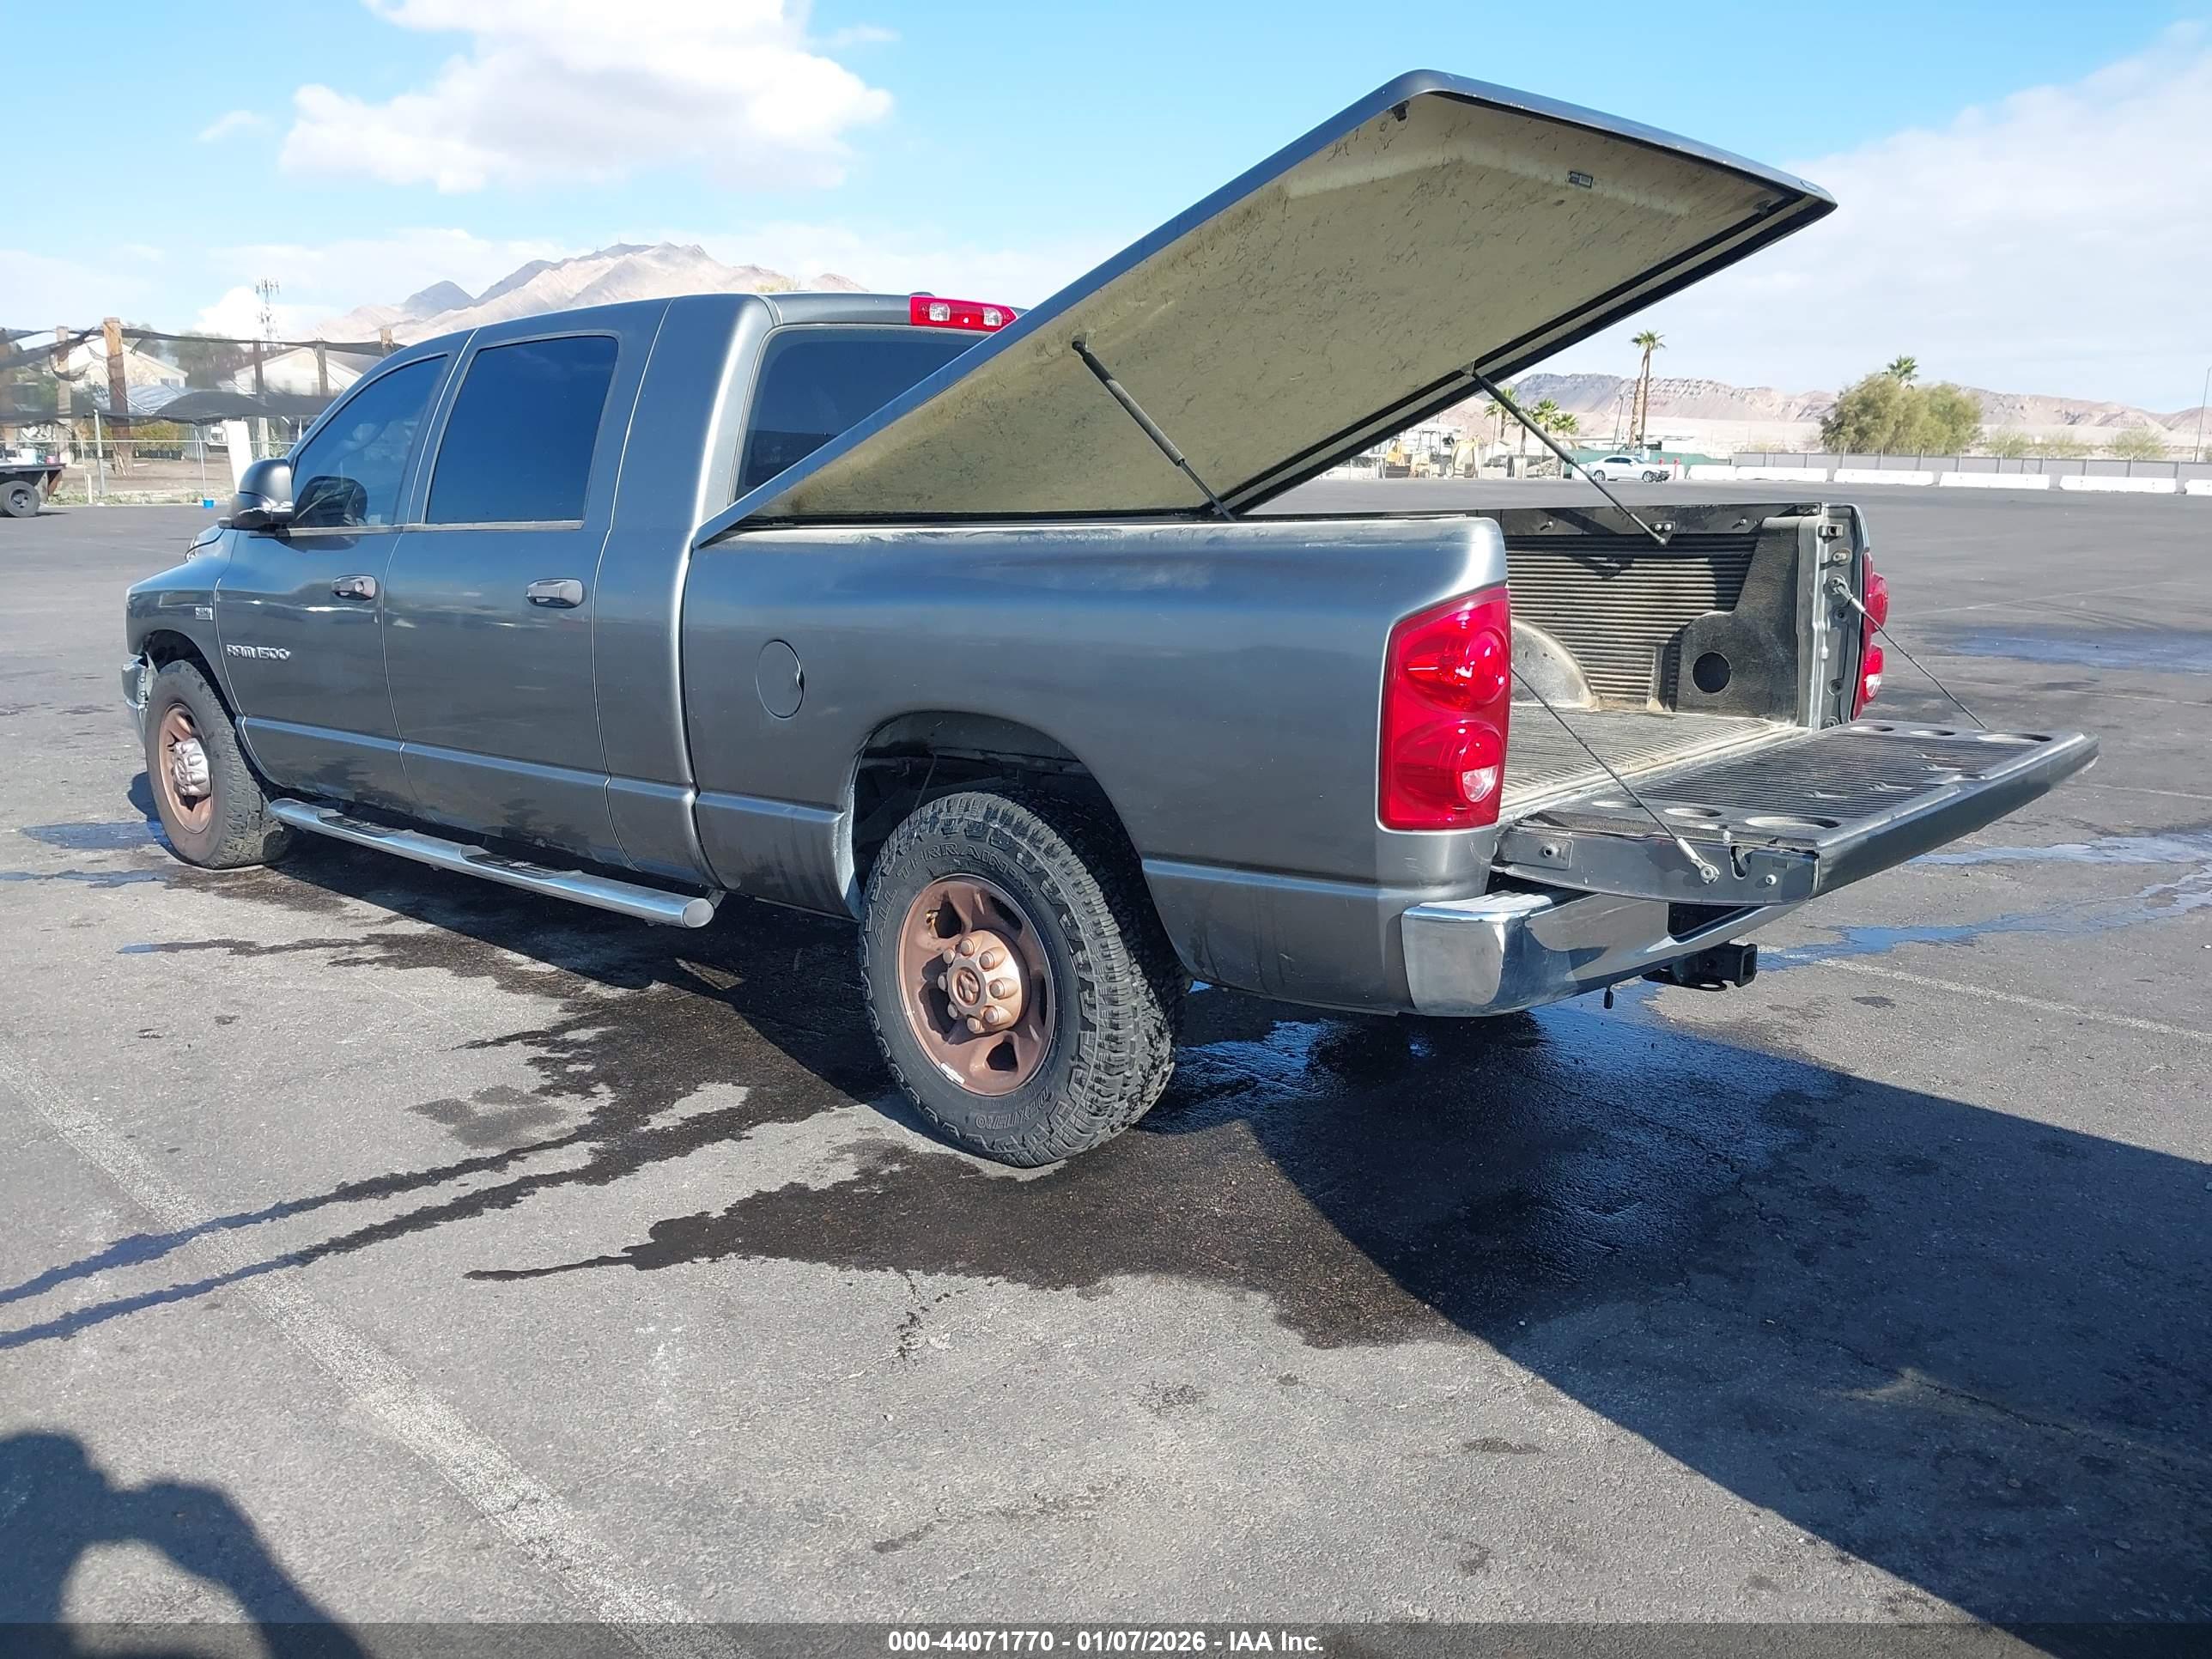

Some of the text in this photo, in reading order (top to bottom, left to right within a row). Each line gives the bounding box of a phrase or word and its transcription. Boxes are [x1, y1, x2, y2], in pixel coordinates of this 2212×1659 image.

[227, 644, 292, 660] RAM 1500
[874, 889, 897, 948] ALL
